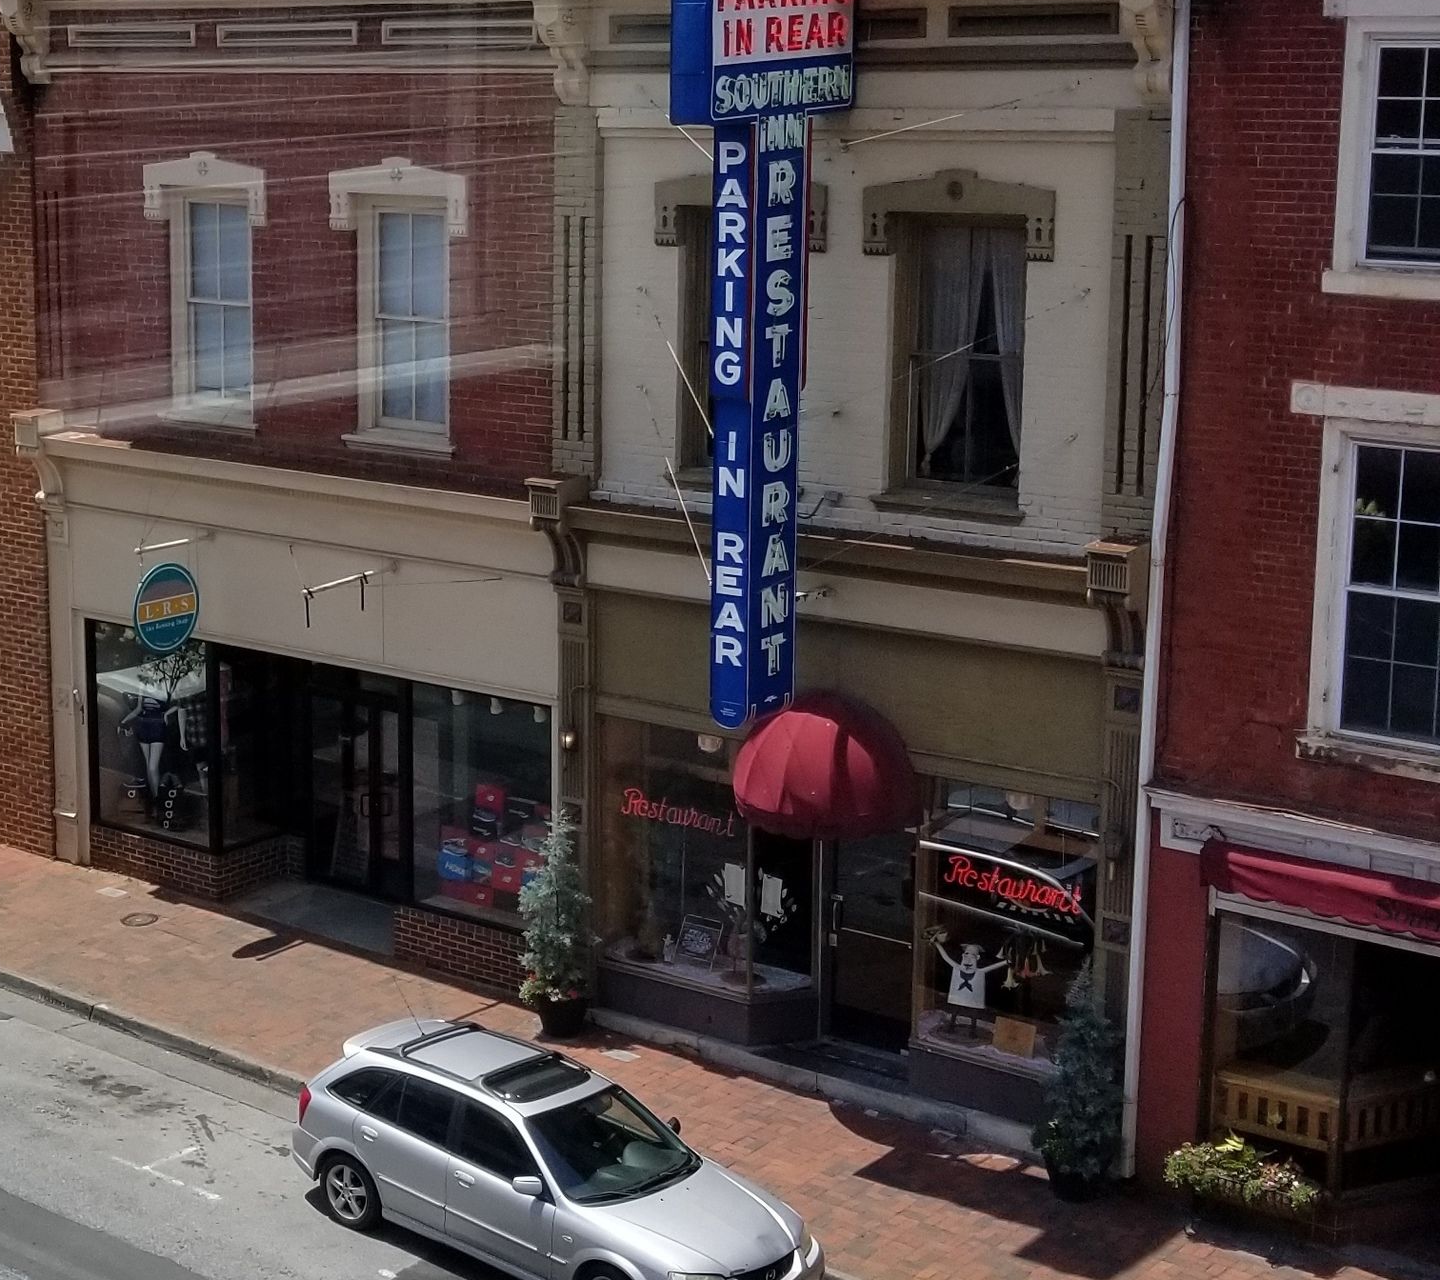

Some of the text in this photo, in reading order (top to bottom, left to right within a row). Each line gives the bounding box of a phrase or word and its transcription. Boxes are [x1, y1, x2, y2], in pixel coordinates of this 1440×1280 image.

[723, 11, 847, 57] IN REAR
[715, 64, 851, 114] SOUTHERN
[760, 115, 805, 153] INN
[714, 141, 747, 667] PARKING IN REAR
[760, 159, 797, 677] RESTAURANT
[620, 788, 735, 837] Restaurant
[944, 855, 1085, 916] Restaurant
